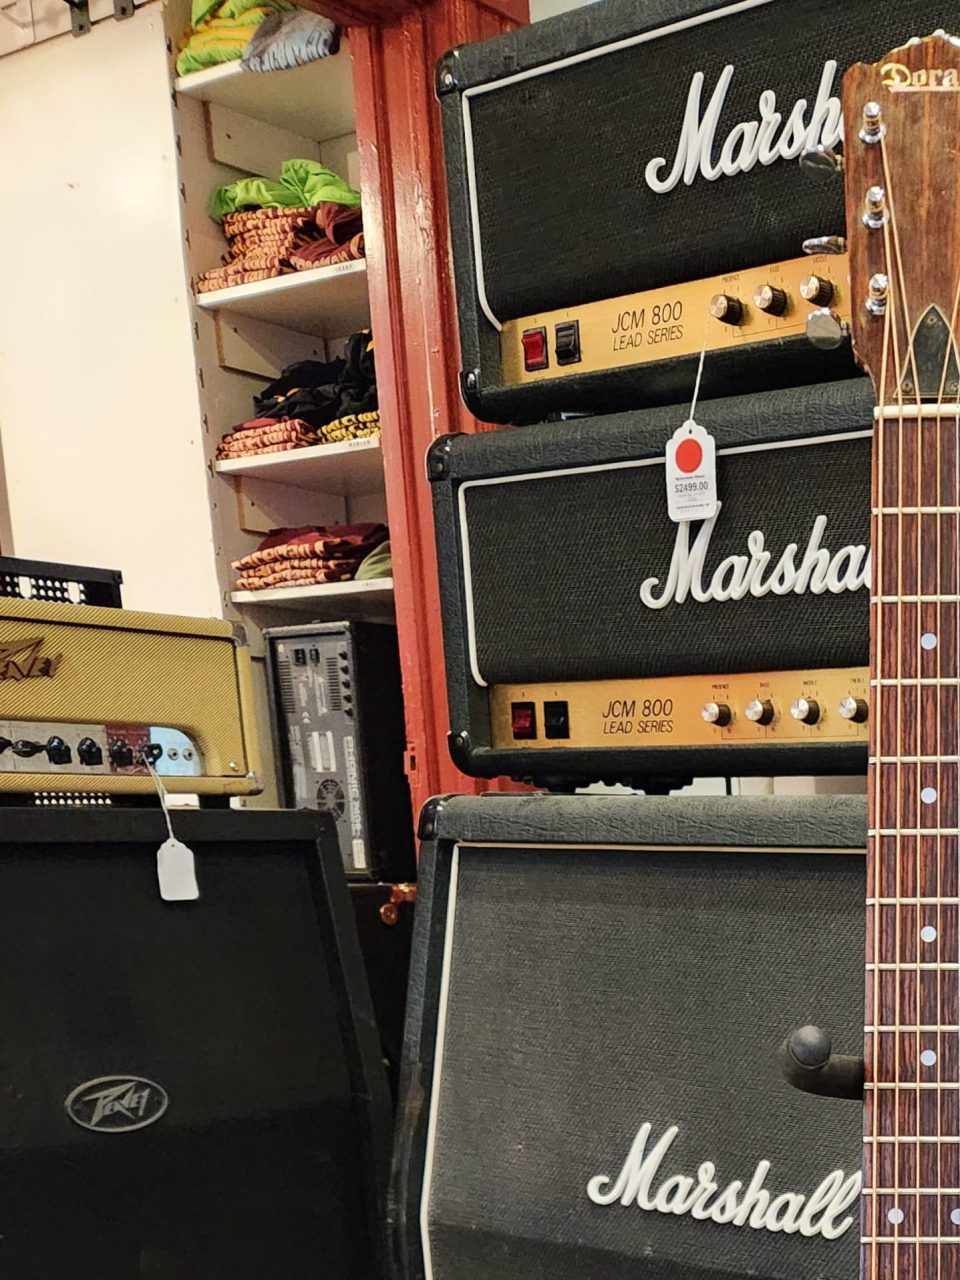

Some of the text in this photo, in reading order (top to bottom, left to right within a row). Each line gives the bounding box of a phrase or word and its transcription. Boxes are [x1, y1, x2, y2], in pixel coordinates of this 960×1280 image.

[645, 60, 845, 193] Marsh
[611, 300, 684, 334] JCM 800
[612, 324, 684, 352] LEAD SERIES
[674, 480, 709, 493] $2499.00
[639, 500, 872, 610] Marsha
[602, 698, 674, 719] JCM 800
[603, 719, 674, 735] LEAD SERIES
[587, 1121, 863, 1241] Marshall
